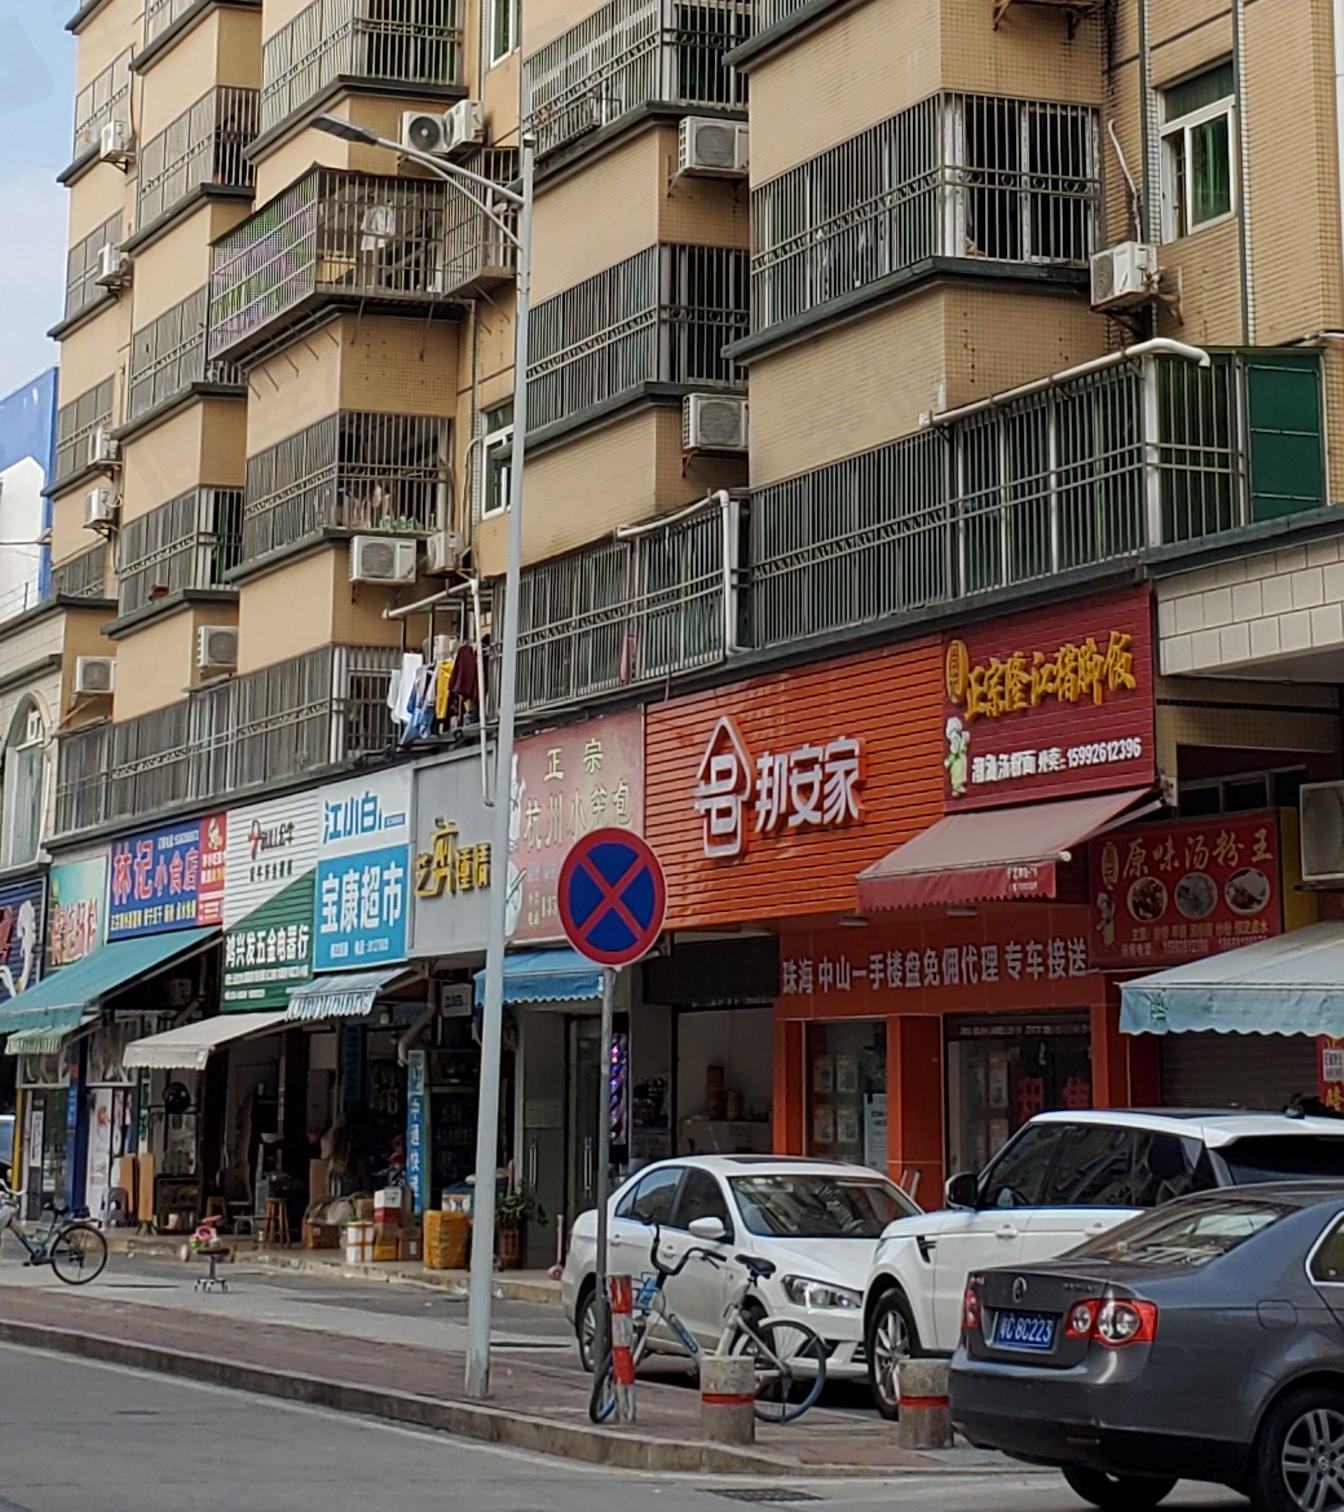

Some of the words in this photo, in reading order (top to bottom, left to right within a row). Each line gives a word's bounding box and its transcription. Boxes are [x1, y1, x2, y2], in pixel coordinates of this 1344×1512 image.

[544, 739, 604, 781] 正宗
[323, 790, 380, 845] 江小白
[1123, 828, 1274, 879] 原味汤粉王
[320, 861, 404, 935] 宝康超市
[782, 959, 814, 994] 珠海
[1005, 937, 1088, 980] 专车接送
